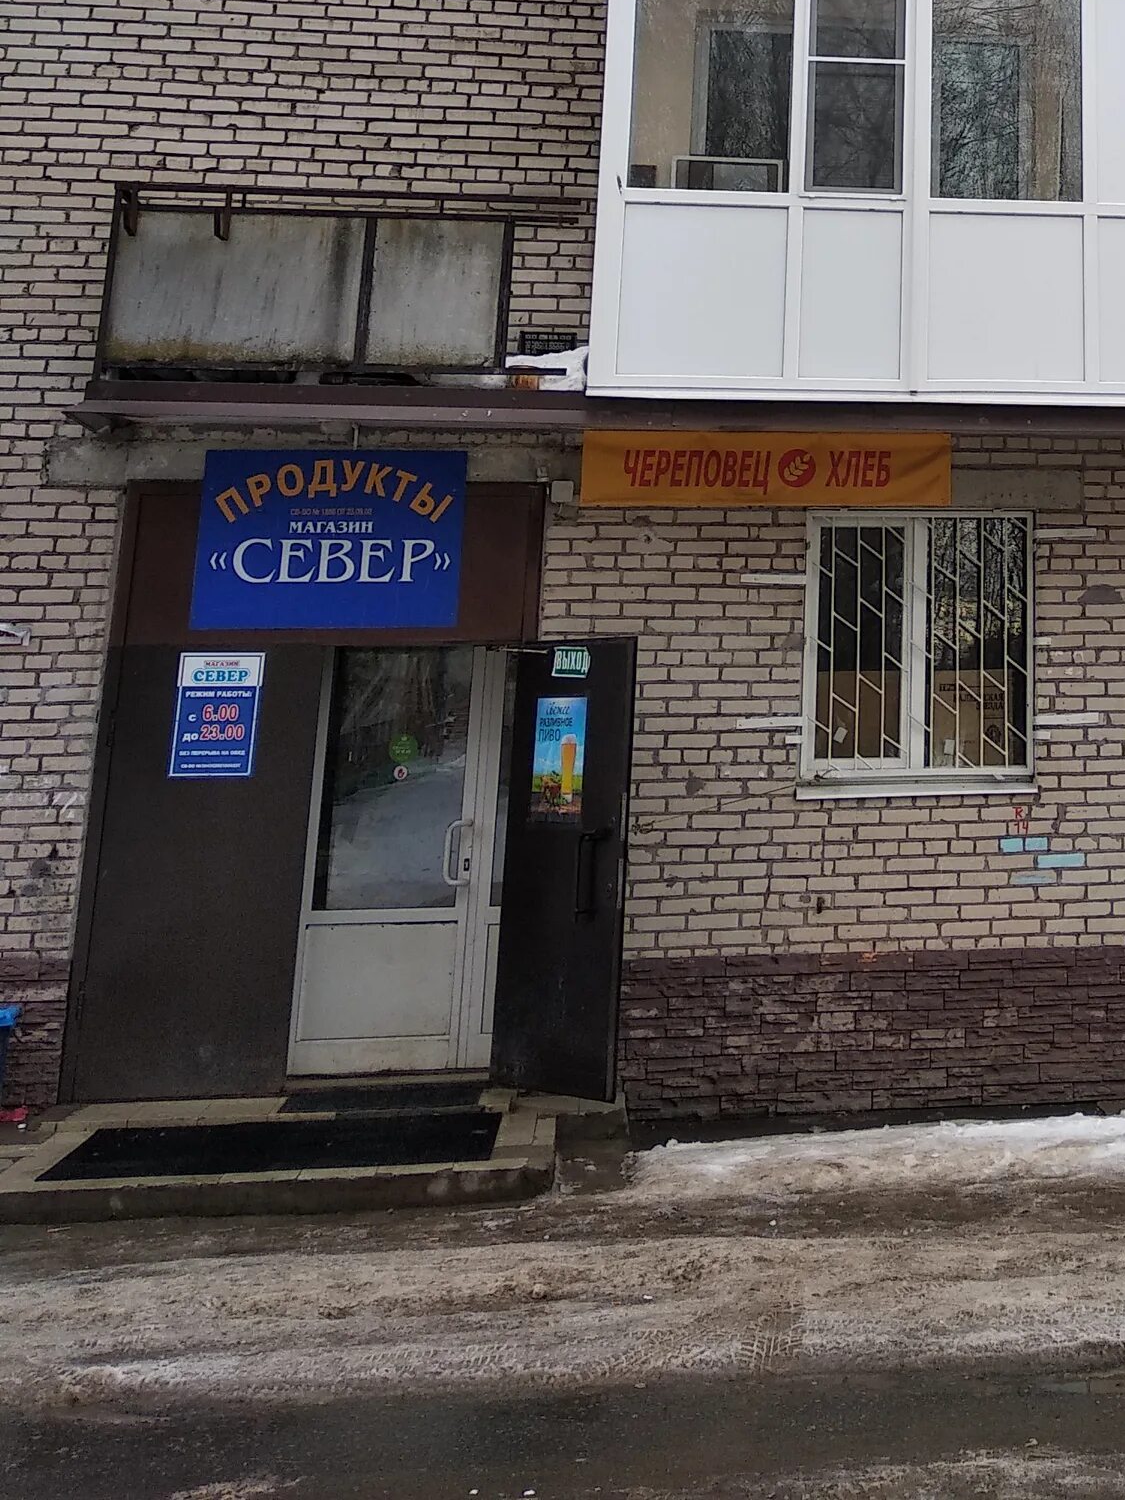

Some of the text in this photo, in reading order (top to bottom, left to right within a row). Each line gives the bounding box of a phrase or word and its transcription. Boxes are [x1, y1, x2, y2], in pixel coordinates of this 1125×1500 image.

[623, 450, 892, 495] ЧЕРЕПОВЕЦ ХЛЕБ
[215, 459, 454, 523] ПРОДУКТЫ
[289, 521, 373, 533] МАГАЗИН
[555, 650, 589, 673] ВЫХОД
[193, 669, 249, 683] СЕВЕР
[202, 704, 239, 722] 6.00
[200, 724, 245, 741] 23.00
[538, 728, 561, 742] ПИВО
